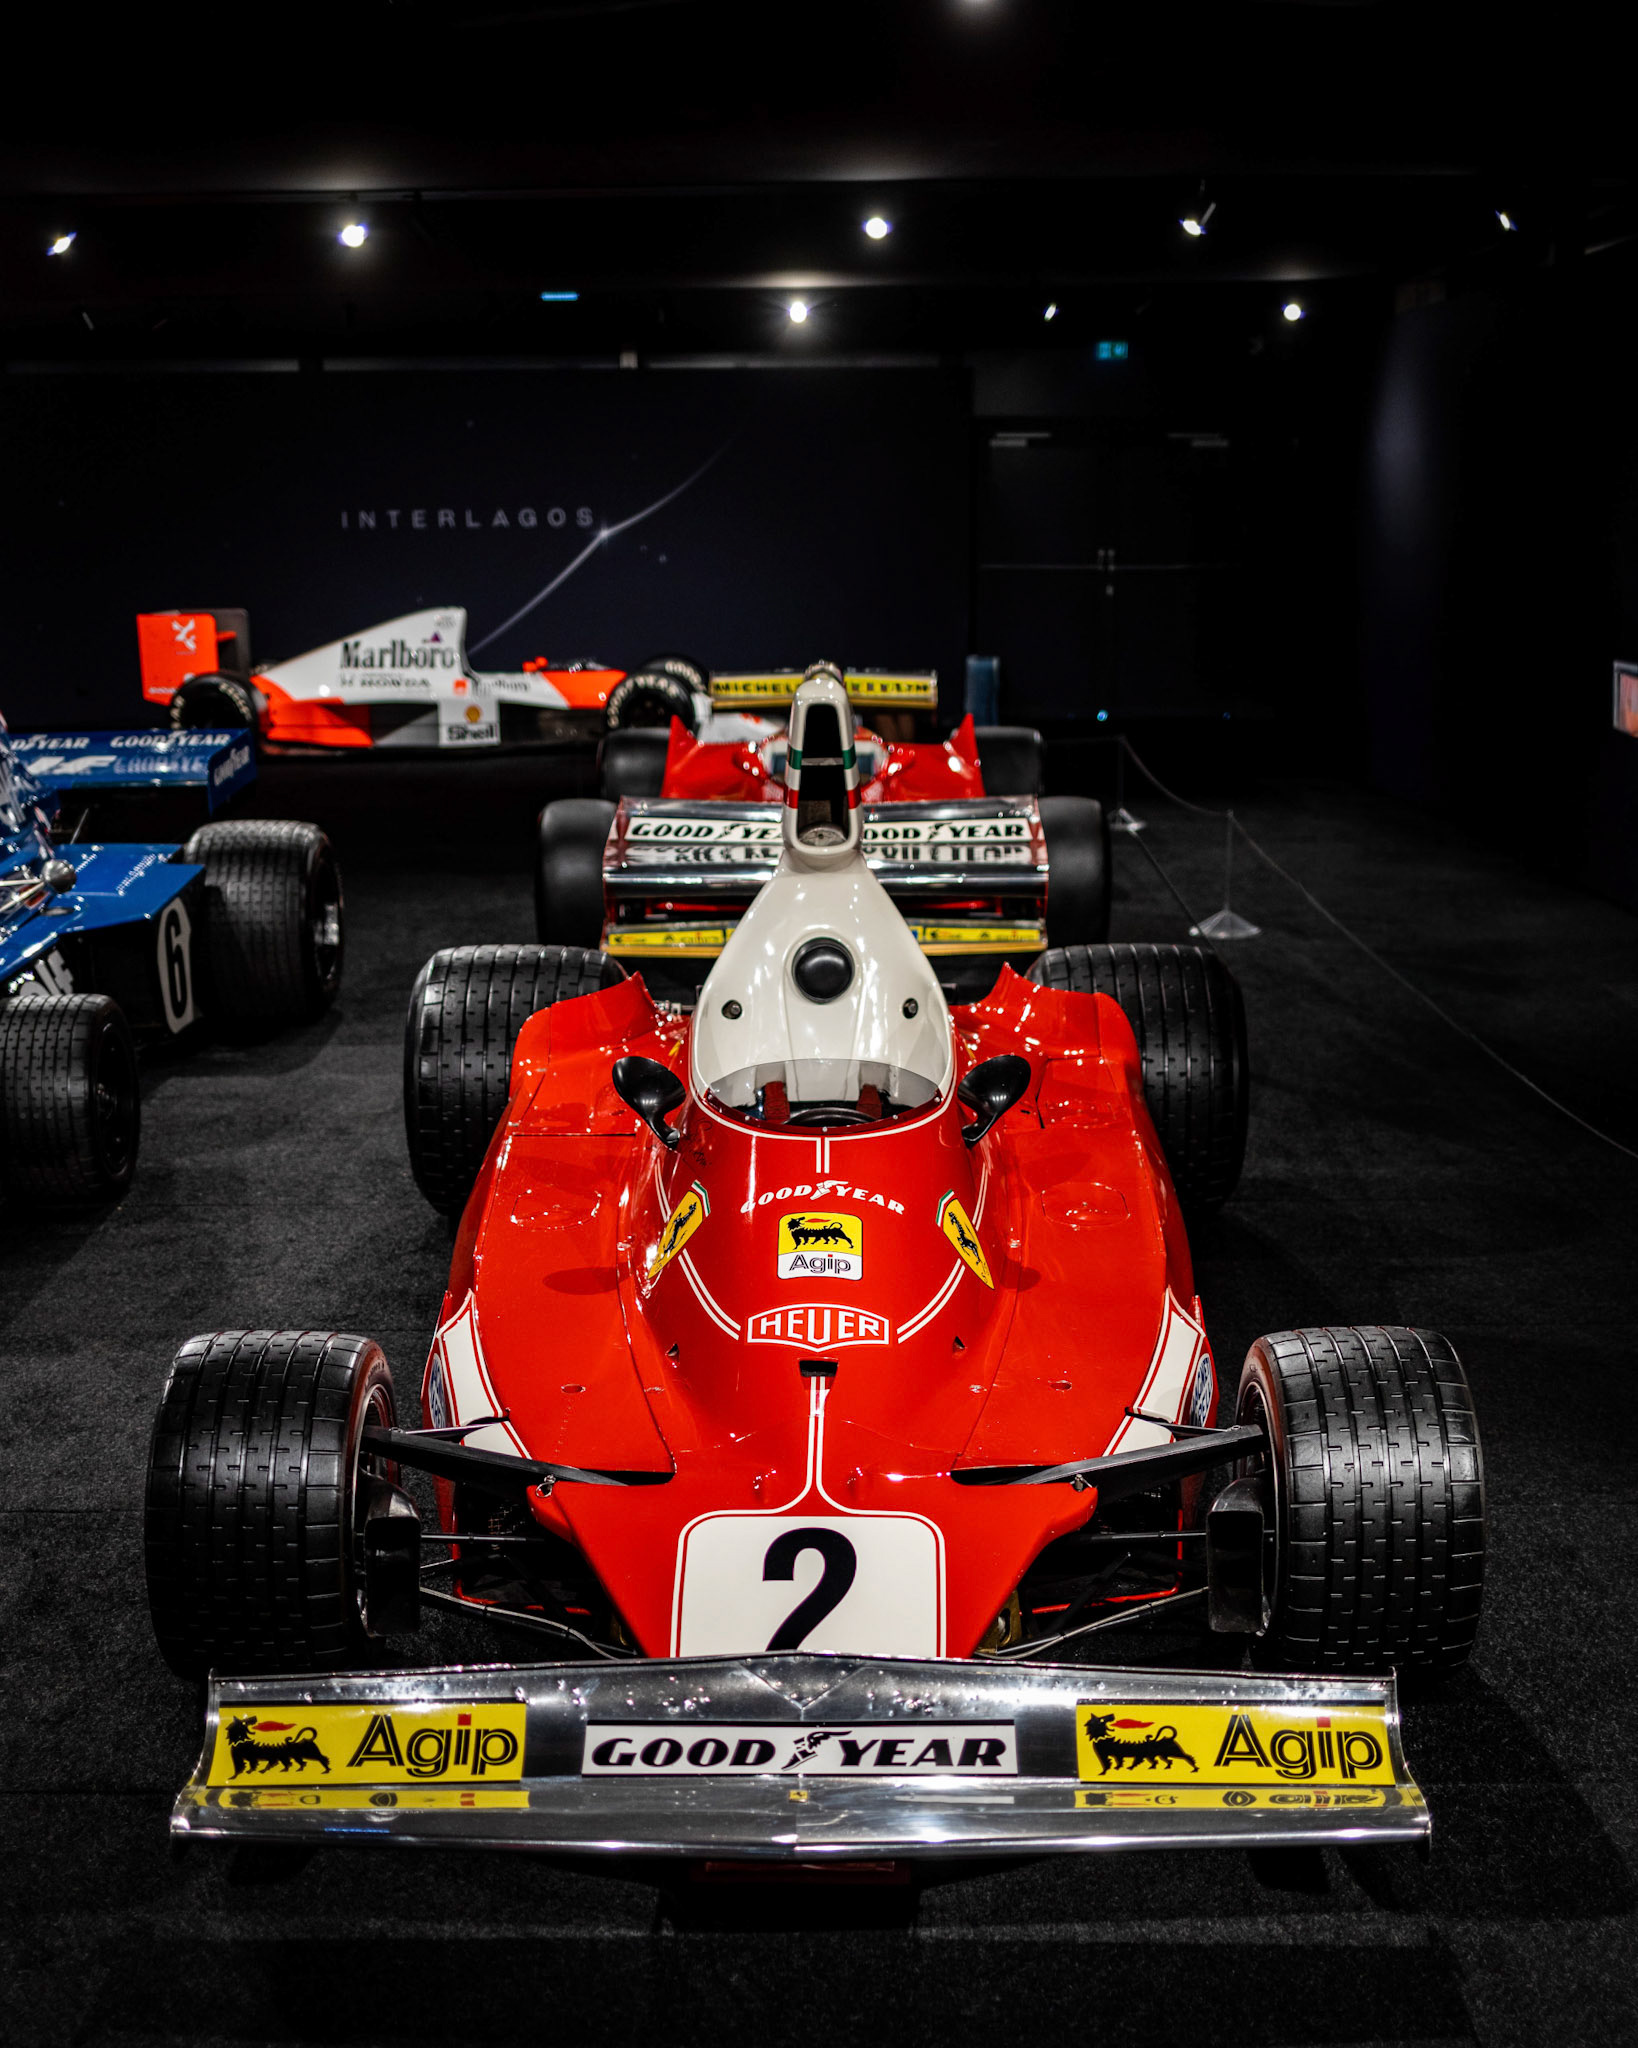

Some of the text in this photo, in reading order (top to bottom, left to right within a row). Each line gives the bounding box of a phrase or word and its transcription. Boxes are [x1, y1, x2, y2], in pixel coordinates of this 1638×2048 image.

[341, 507, 593, 529] INTERLAGOS
[341, 639, 456, 669] Marlboro
[714, 681, 796, 695] MICHEL
[449, 724, 496, 741] Shell
[631, 822, 714, 838] GOOD
[863, 823, 1025, 841] OOD YEAR
[163, 905, 190, 1022] 6
[740, 1184, 905, 1215] GOOD YEAR
[788, 1253, 852, 1275] Agip
[760, 1309, 880, 1345] HEUER
[762, 1527, 857, 1652] 2
[346, 1713, 519, 1778] Agip
[591, 1737, 1008, 1768] GOOD YEAR
[1213, 1713, 1384, 1779] Agip
